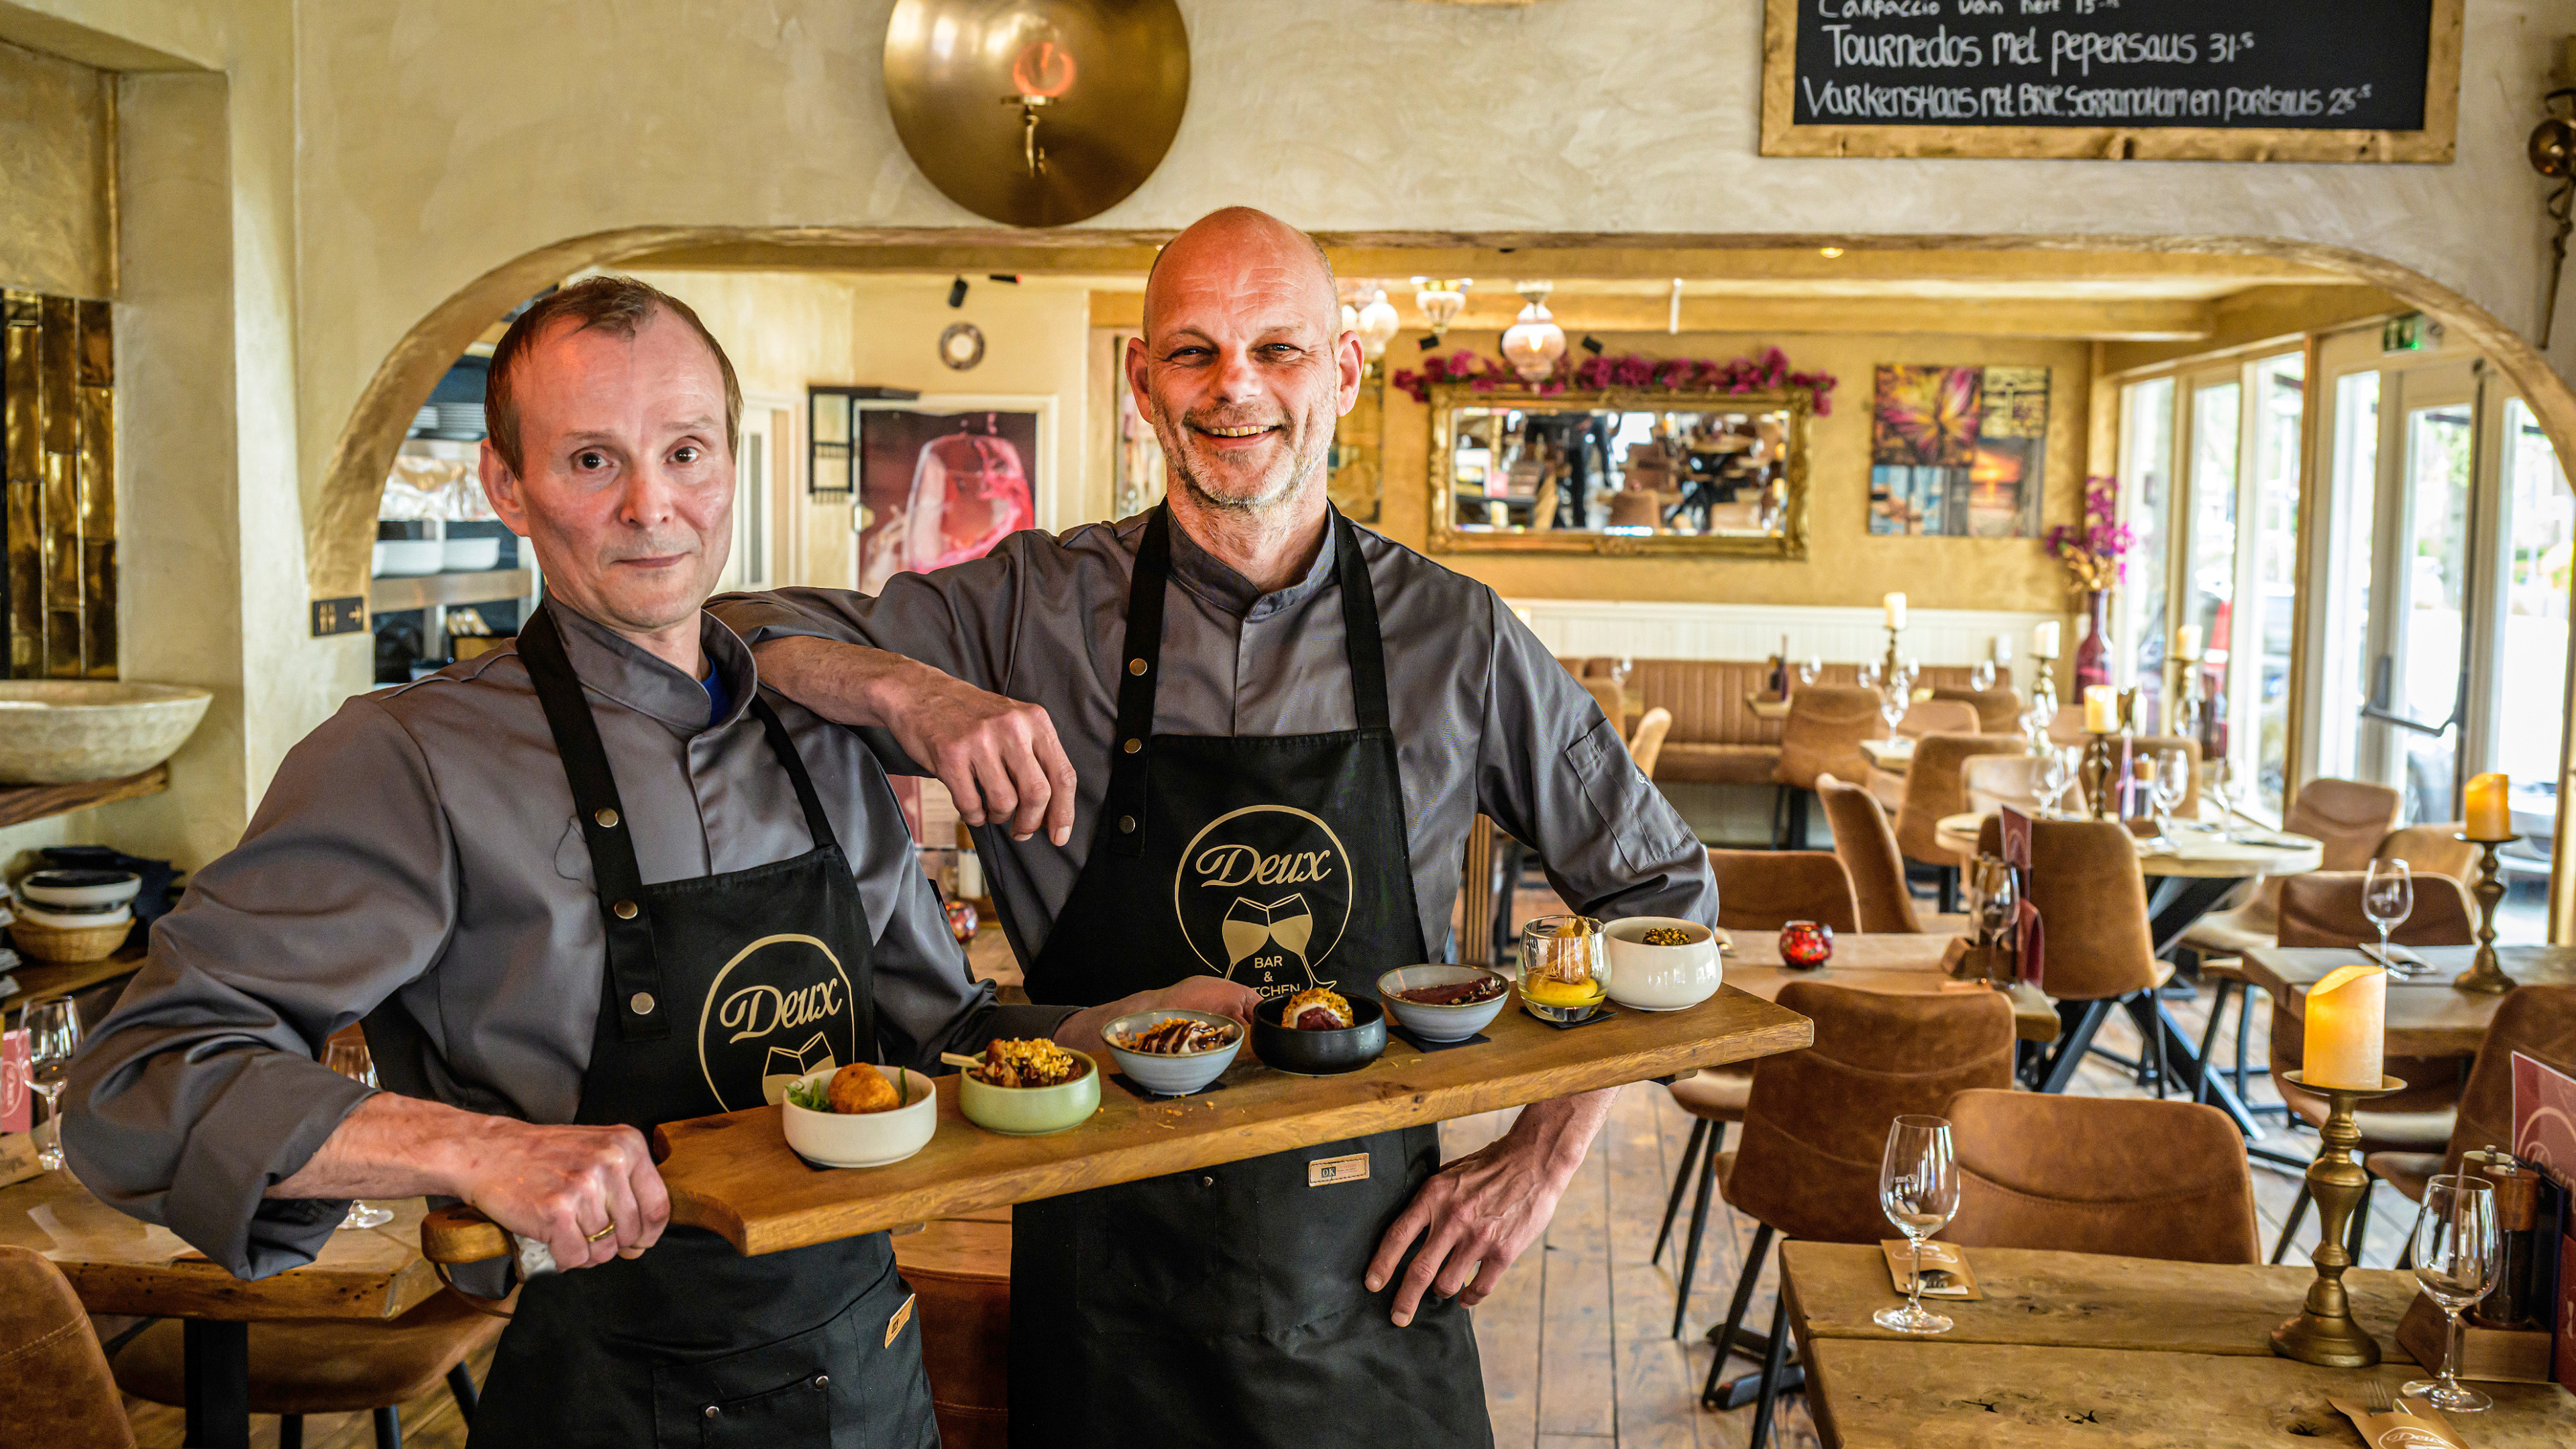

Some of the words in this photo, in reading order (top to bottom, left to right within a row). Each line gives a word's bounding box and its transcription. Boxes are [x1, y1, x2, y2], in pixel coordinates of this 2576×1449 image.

[1195, 844, 1332, 888] Deux
[1254, 956, 1283, 969] BAR
[1263, 971, 1274, 982] &
[1250, 983, 1301, 998] TCHEN
[719, 978, 843, 1044] Deux
[1322, 1168, 1335, 1176] OK
